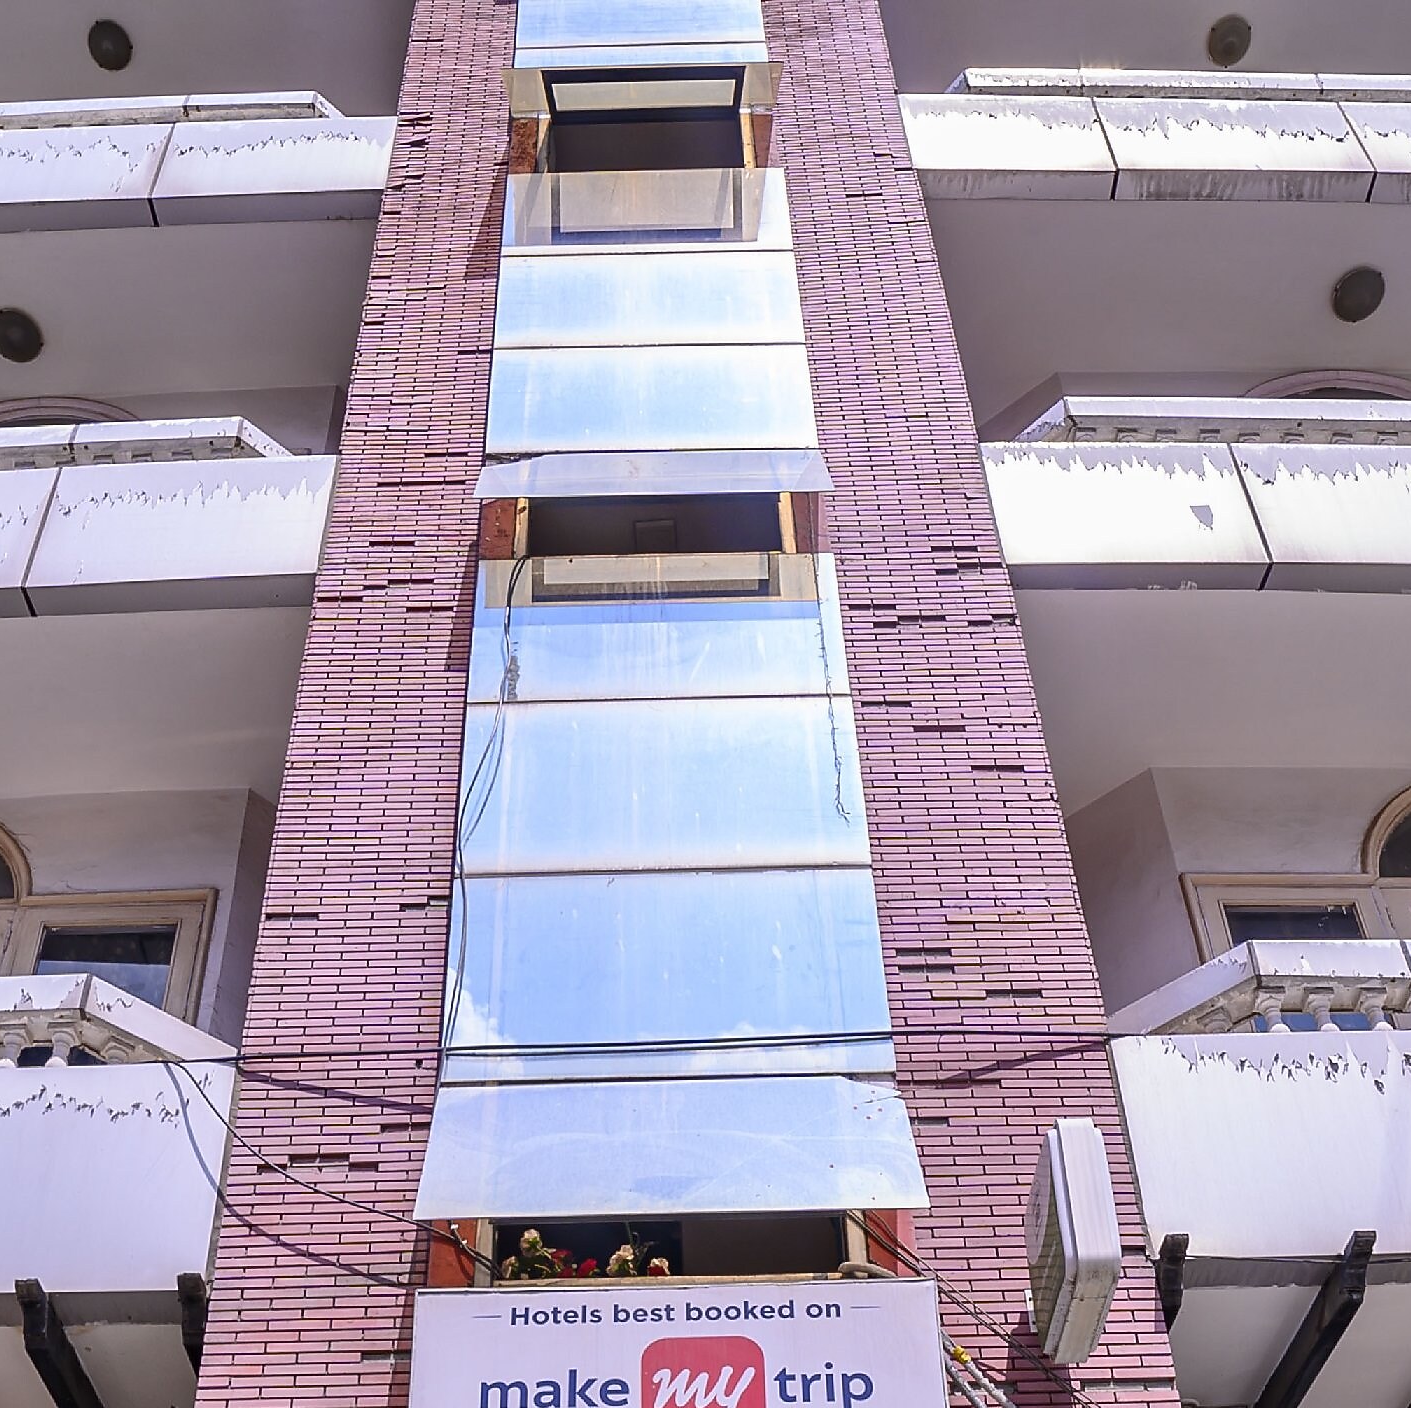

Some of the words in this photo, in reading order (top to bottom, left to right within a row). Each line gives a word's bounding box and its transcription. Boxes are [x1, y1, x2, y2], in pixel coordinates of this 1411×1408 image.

[509, 1304, 602, 1326] Hotels
[612, 1303, 676, 1325] best
[684, 1300, 796, 1322] booked
[805, 1301, 842, 1320] on
